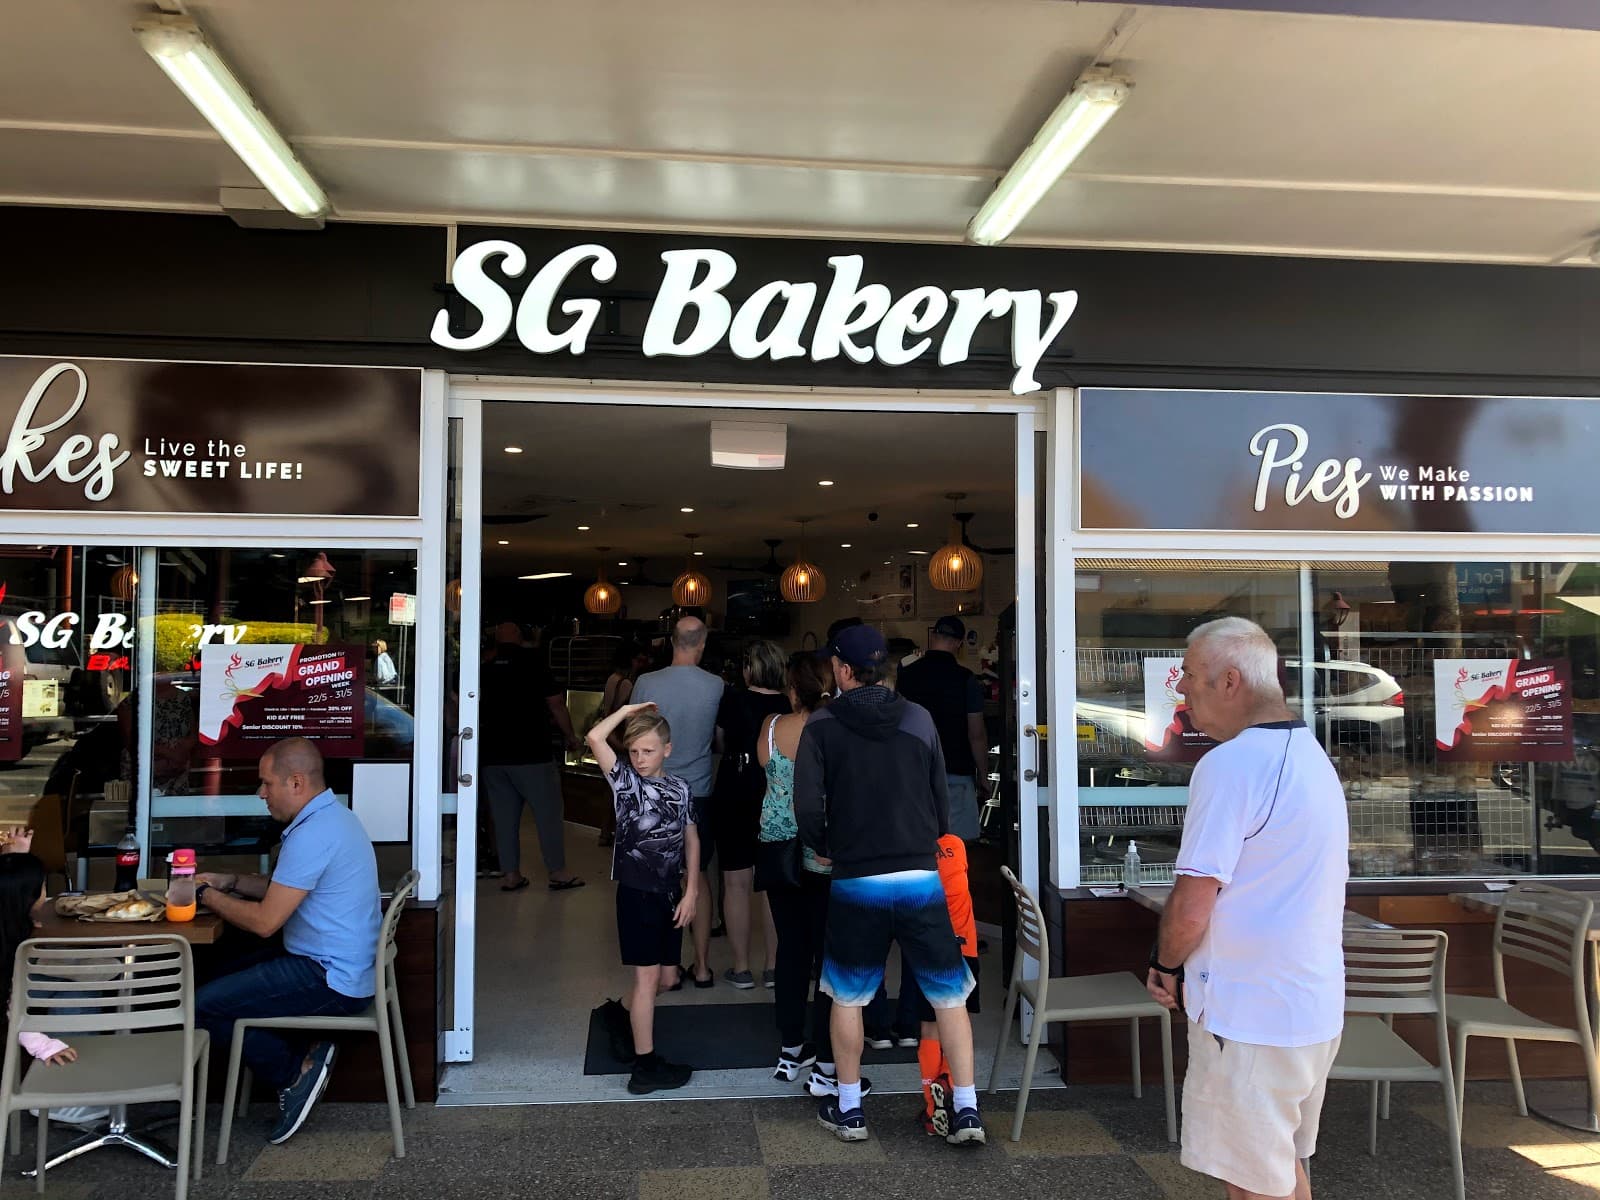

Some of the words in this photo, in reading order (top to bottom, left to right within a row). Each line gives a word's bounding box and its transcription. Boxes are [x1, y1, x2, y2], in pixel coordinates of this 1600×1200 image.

[430, 239, 617, 354] SG
[642, 248, 1079, 394] Bakery
[144, 438, 195, 456] Live
[207, 439, 246, 457] the
[143, 459, 229, 478] SWEET
[240, 462, 303, 480] LIFE!
[1249, 423, 1373, 519] Pies
[1380, 465, 1409, 482] We
[1419, 466, 1470, 482] Make
[1380, 484, 1435, 501] WITH
[1444, 485, 1534, 502] PASSION
[9, 611, 80, 649] SG
[244, 660, 255, 668] SG
[257, 655, 284, 666] Bakery
[299, 652, 337, 664] PROMOTION
[298, 660, 340, 676] GRAND
[305, 671, 353, 687] OPENING
[331, 681, 350, 689] WEEK
[1515, 674, 1551, 688] GRAND
[307, 692, 328, 704] 22/5
[335, 687, 352, 699] 31/5
[1522, 683, 1562, 698] OPENING
